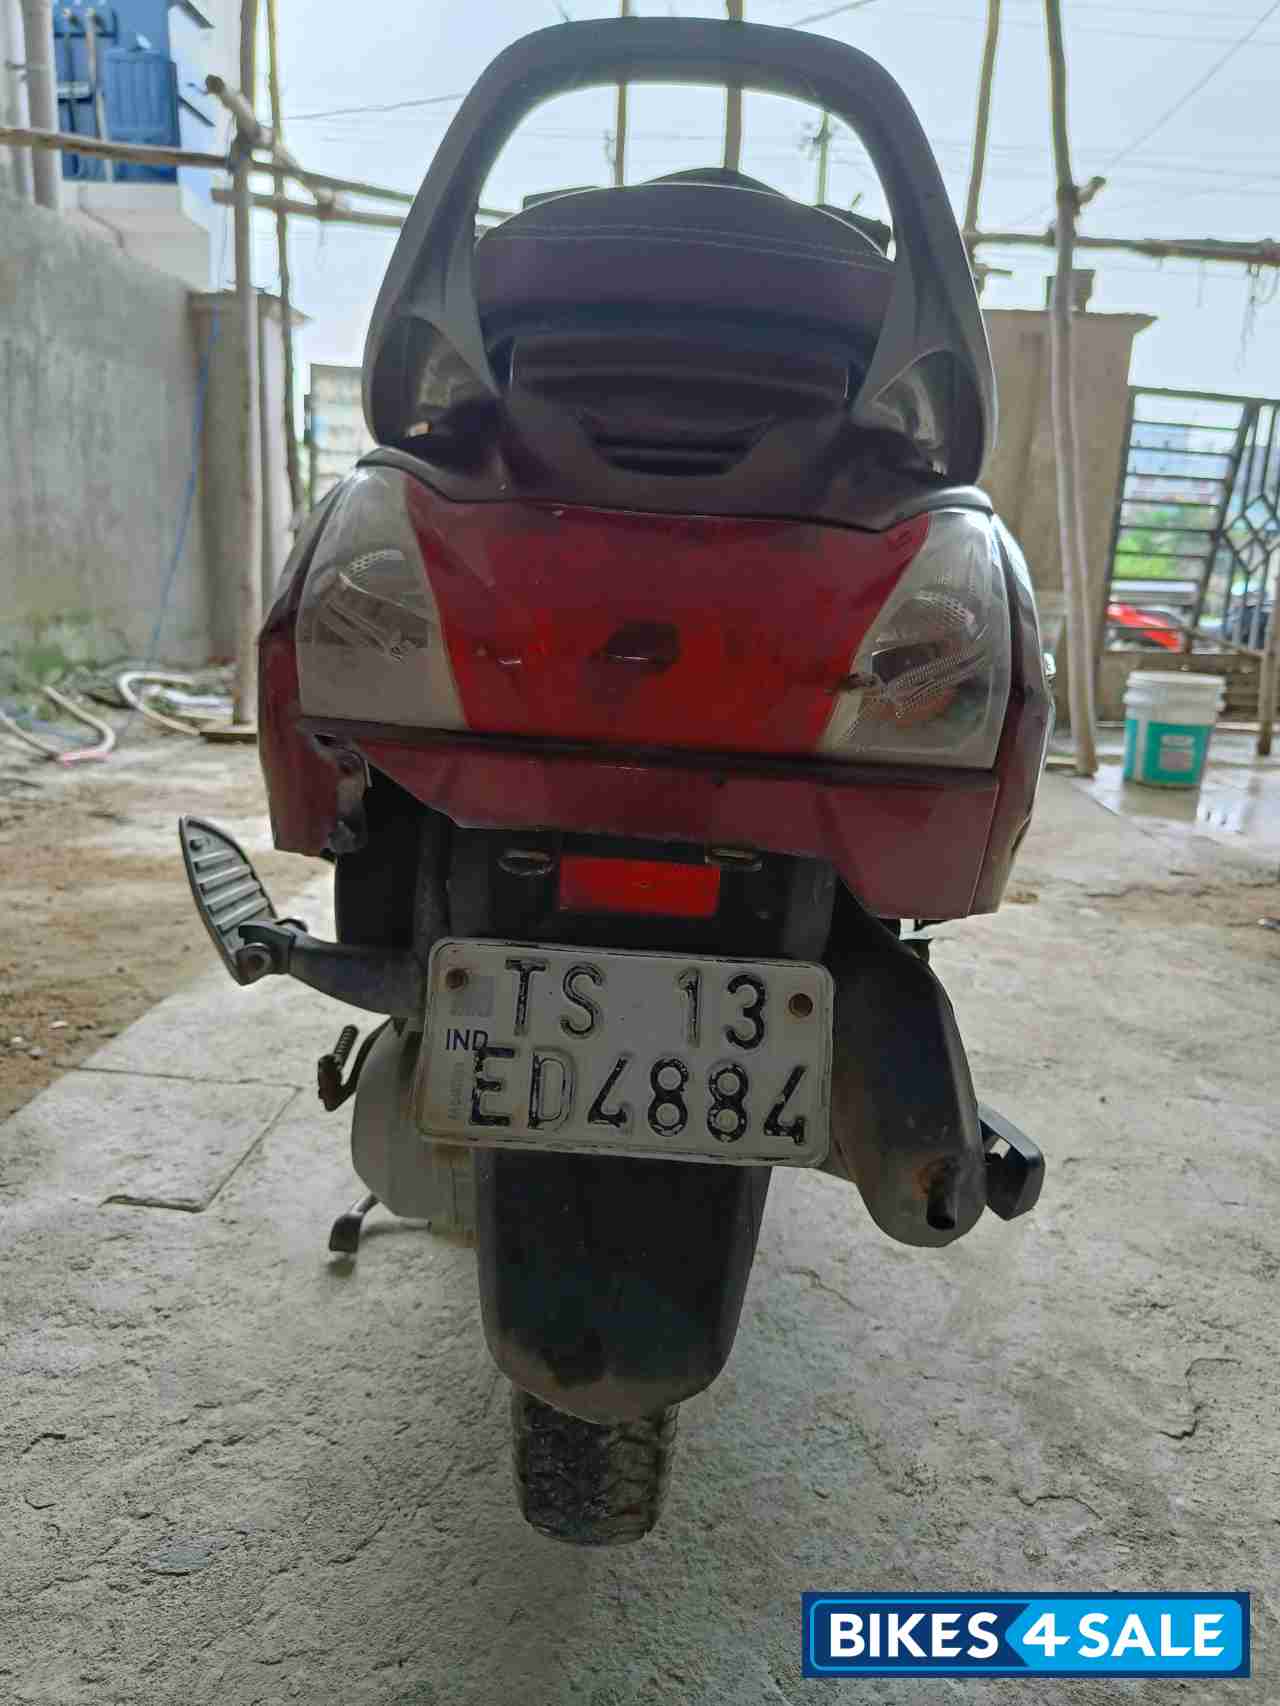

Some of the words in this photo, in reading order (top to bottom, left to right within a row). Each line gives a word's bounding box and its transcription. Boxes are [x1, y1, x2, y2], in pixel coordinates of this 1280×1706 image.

[445, 1028, 489, 1051] IND
[504, 958, 604, 1039] TS
[678, 967, 769, 1051] 13
[469, 1046, 808, 1145] ED4884
